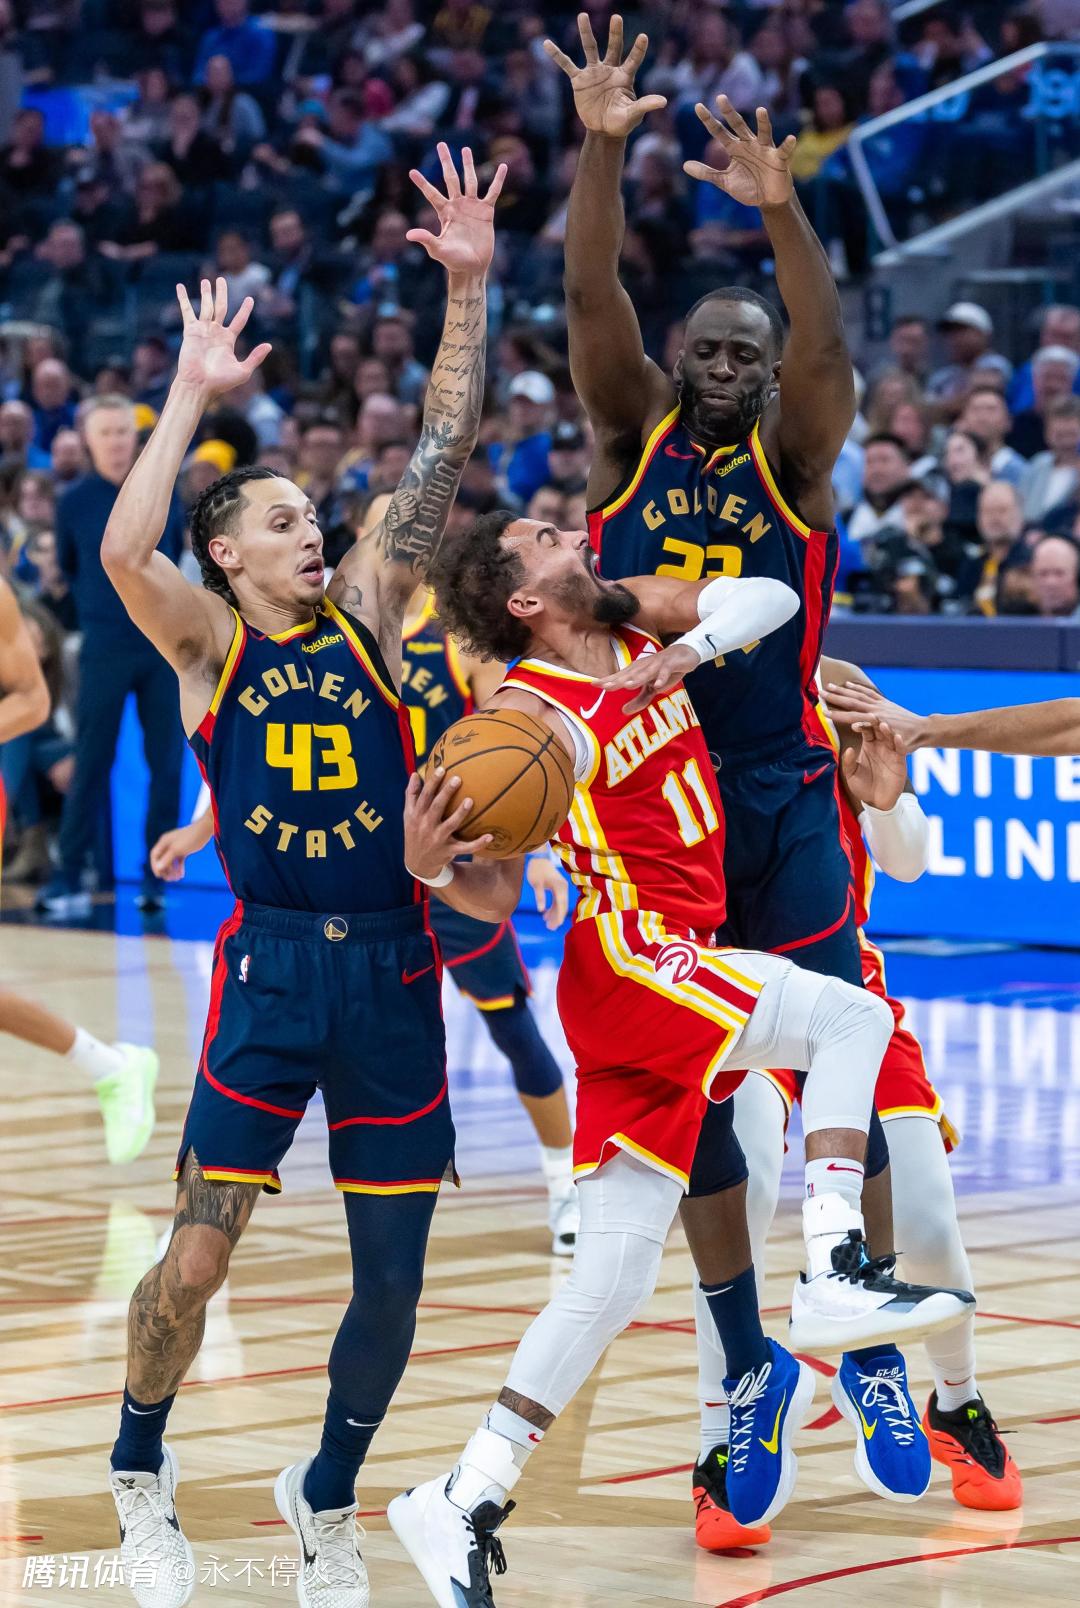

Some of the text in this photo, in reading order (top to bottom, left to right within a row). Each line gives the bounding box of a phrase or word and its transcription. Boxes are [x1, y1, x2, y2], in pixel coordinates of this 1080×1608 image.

[642, 485, 773, 544] GOLDEN
[238, 663, 371, 719] GOLEN
[266, 723, 358, 791] 43
[244, 800, 384, 858] STATE
[661, 757, 720, 848] 11
